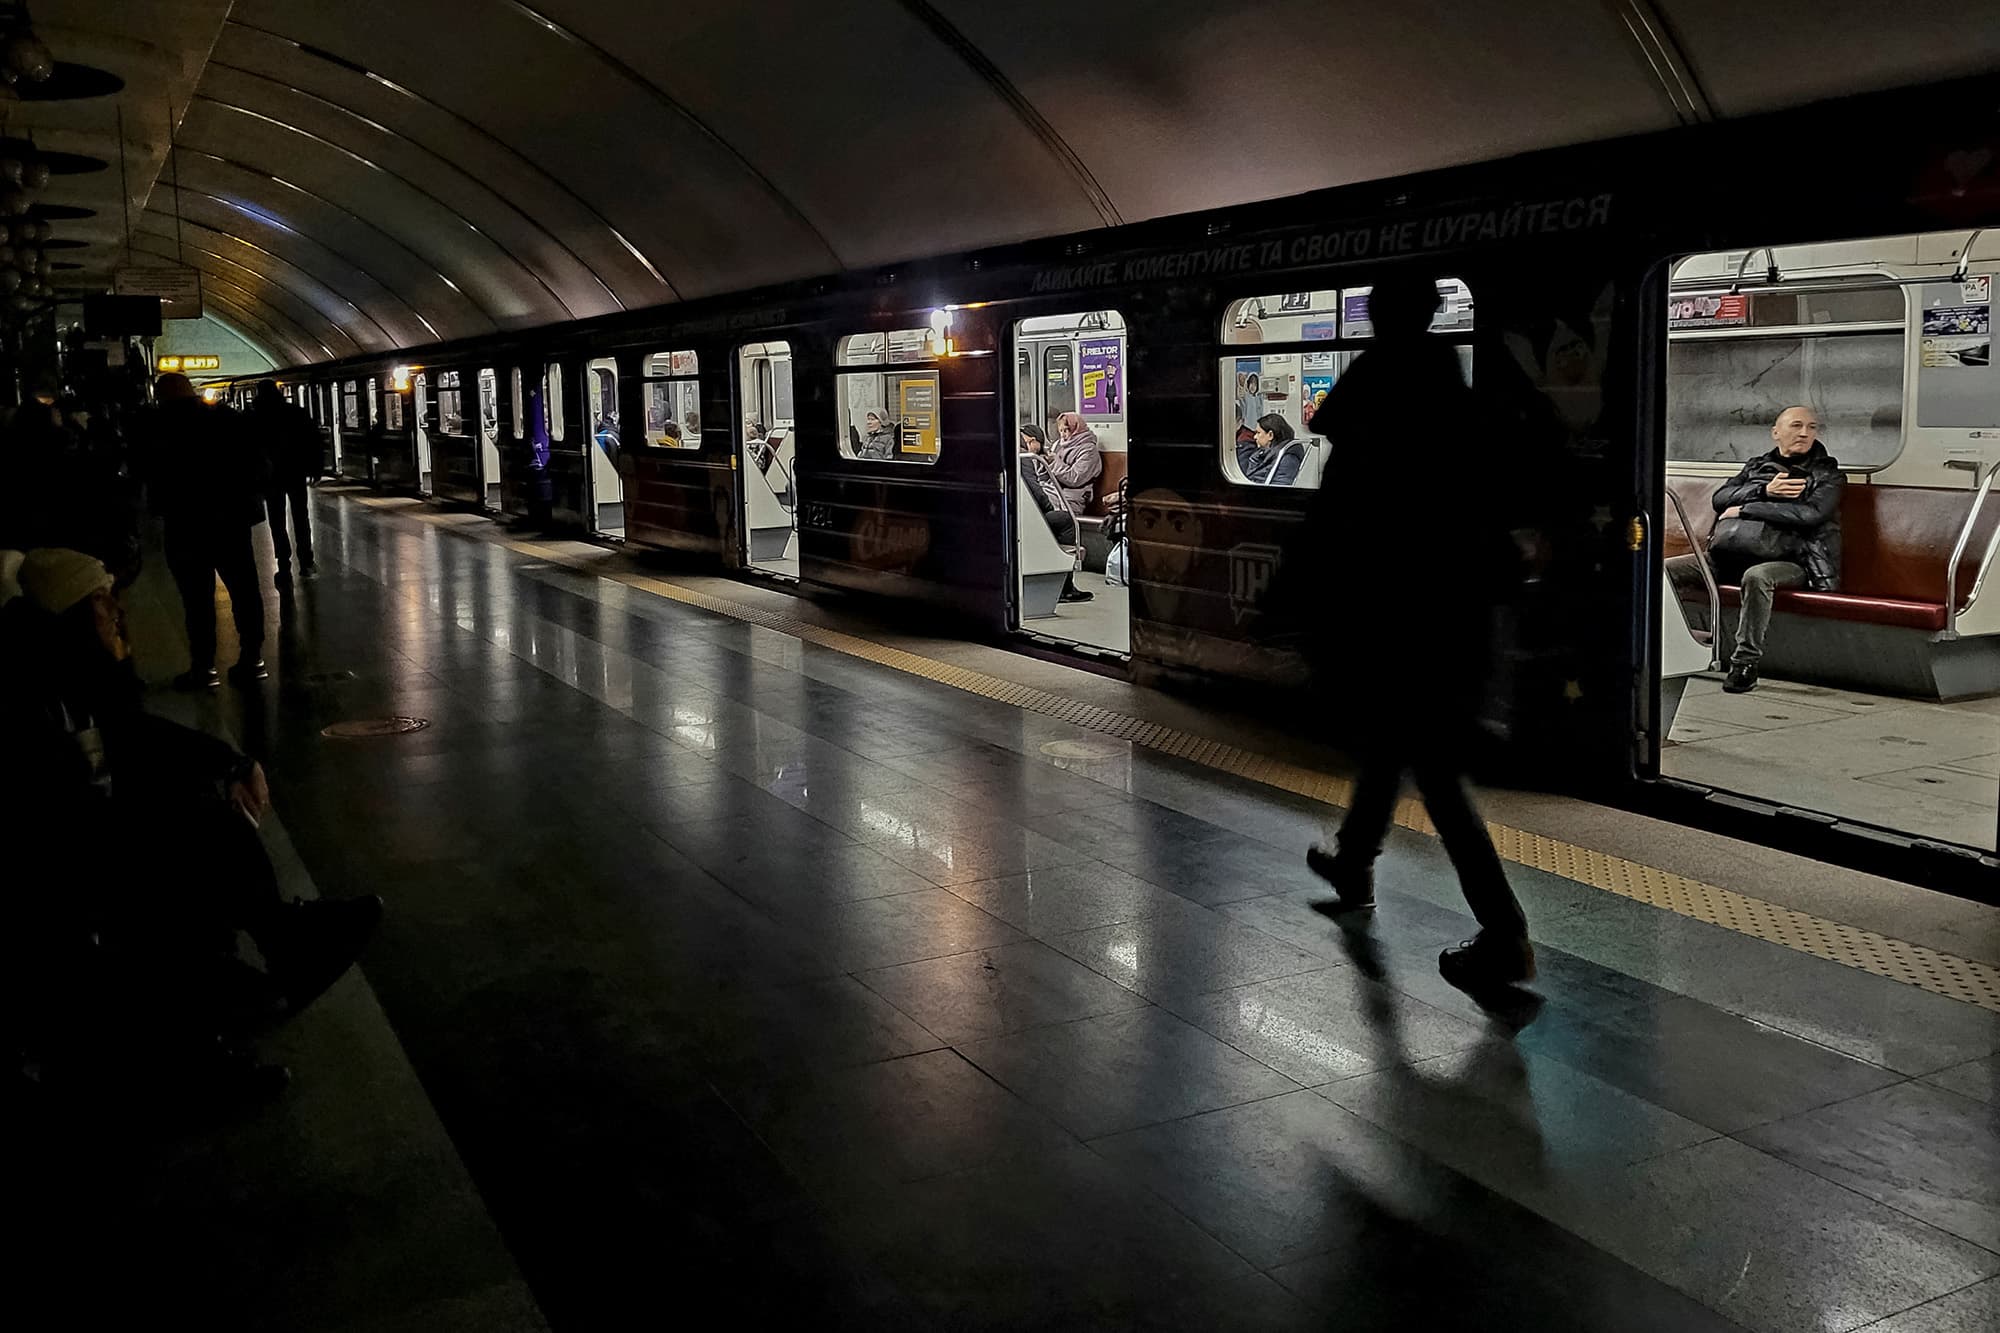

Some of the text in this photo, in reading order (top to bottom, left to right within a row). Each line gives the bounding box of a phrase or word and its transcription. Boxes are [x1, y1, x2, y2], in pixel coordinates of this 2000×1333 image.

[1258, 240, 1283, 265] ТА
[1290, 228, 1371, 262] СВОГО
[1378, 221, 1418, 254] НЕ
[1423, 192, 1614, 248] ЦУРАЙТЕСЯ
[1086, 345, 1118, 356] RIELTOR
